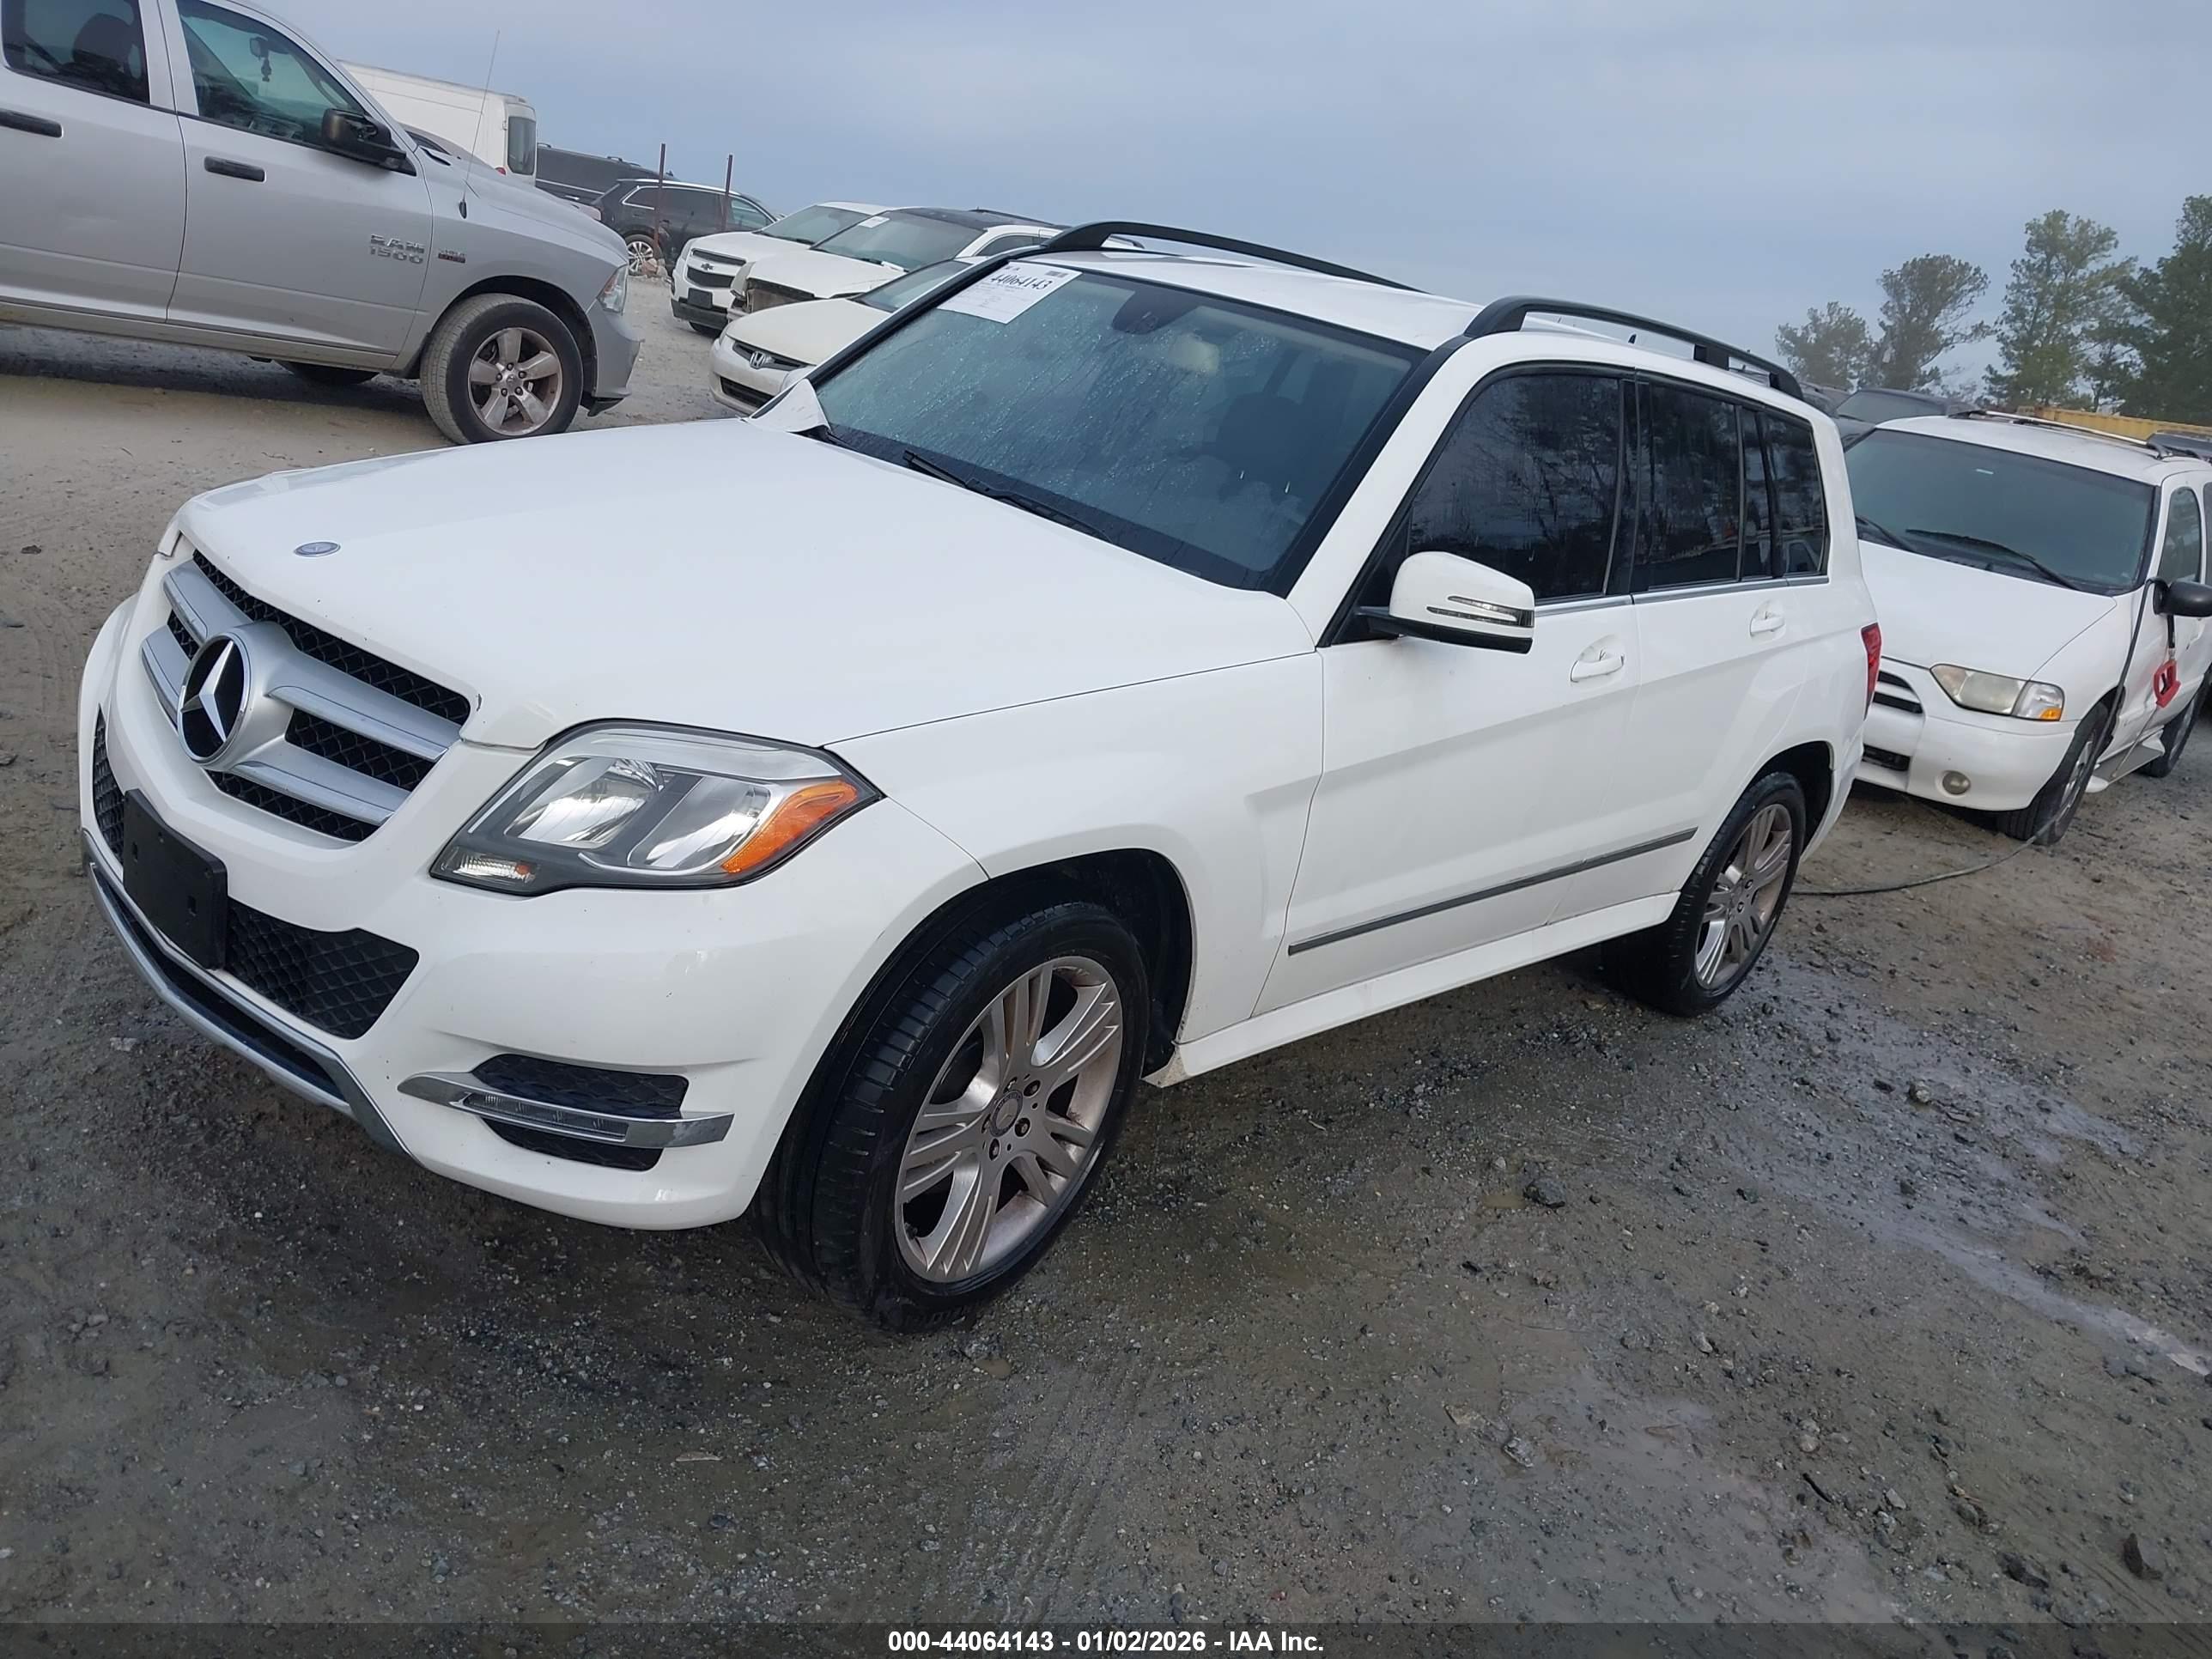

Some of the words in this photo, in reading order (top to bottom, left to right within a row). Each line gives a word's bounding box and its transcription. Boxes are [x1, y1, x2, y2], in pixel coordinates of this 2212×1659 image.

[370, 234, 424, 253] RAM
[370, 246, 423, 264] 1500
[991, 273, 1053, 290] 44064143
